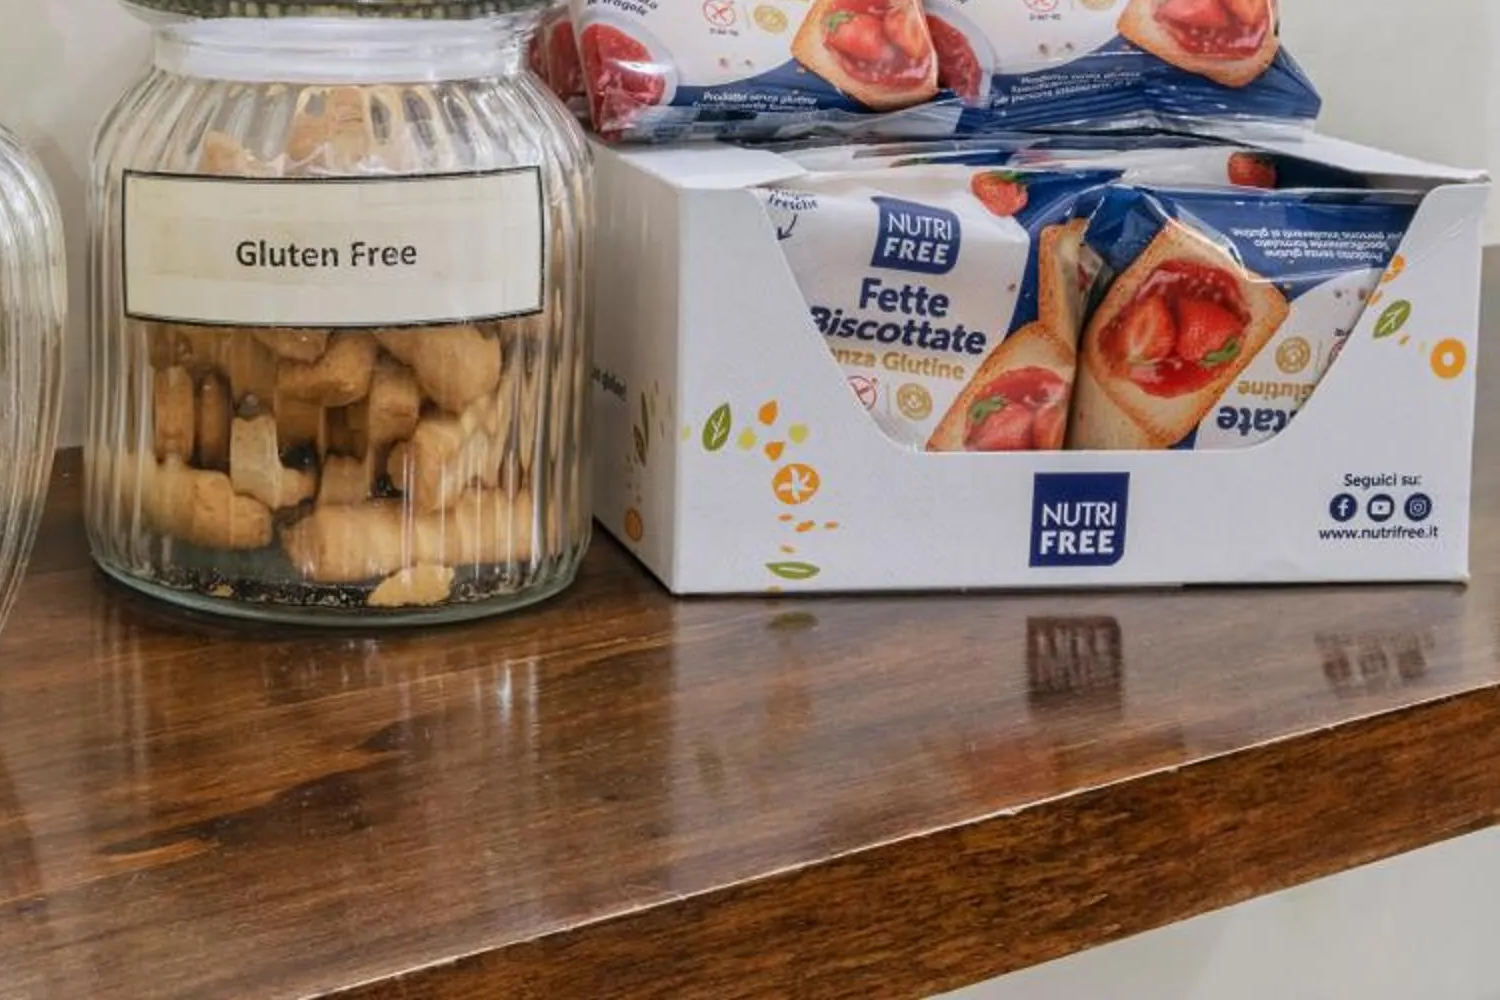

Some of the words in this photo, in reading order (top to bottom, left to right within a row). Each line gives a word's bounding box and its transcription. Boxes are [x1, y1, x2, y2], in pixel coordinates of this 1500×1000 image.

[887, 211, 953, 241] NUTRI
[235, 240, 339, 268] Gluten
[350, 241, 417, 267] Free
[882, 237, 950, 265] FREE
[859, 277, 950, 318] Fette
[882, 350, 966, 380] Glutine
[1343, 472, 1398, 490] Seguici
[1400, 474, 1423, 488] su:
[1041, 502, 1119, 529] NUTRI
[1038, 529, 1115, 556] FREE
[1317, 524, 1439, 541] www.nutrifree.it
